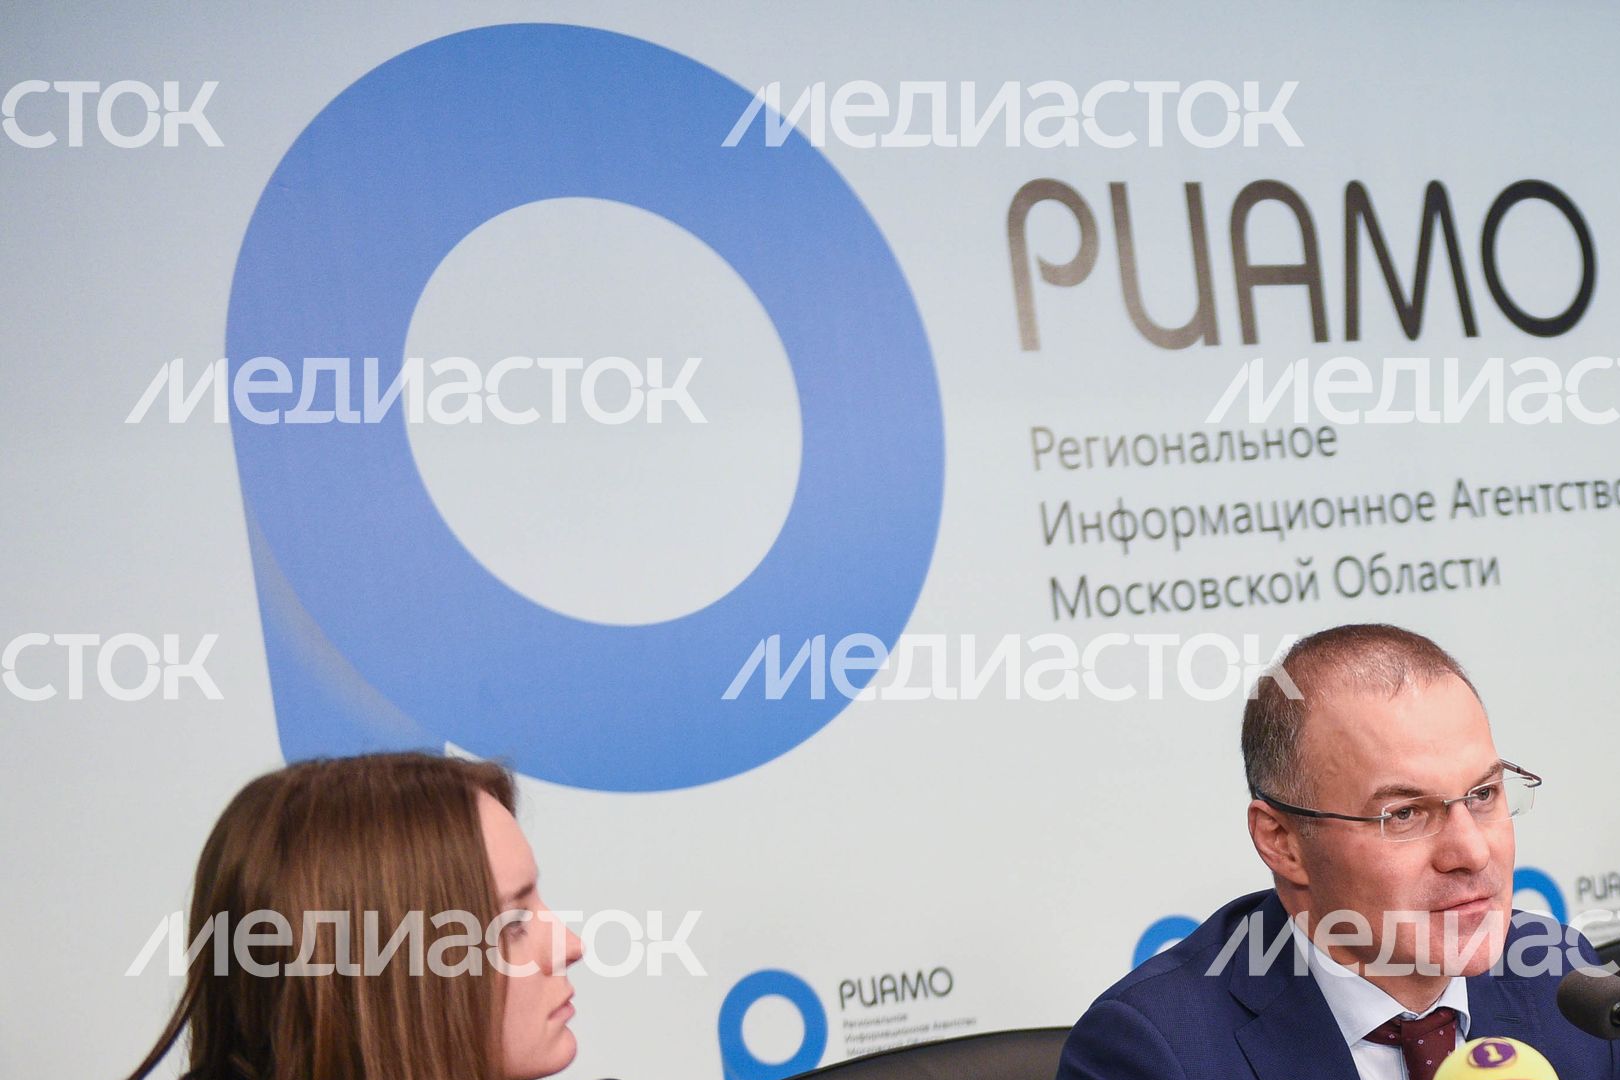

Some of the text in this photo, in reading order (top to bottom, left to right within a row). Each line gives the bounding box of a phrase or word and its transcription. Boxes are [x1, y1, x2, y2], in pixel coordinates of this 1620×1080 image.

[1005, 177, 1598, 351] РИАМО
[1030, 424, 1339, 472] Региональное
[1039, 487, 1438, 555] Информационное
[1050, 552, 1502, 622] Московской Области
[838, 966, 954, 1011] РИАМО
